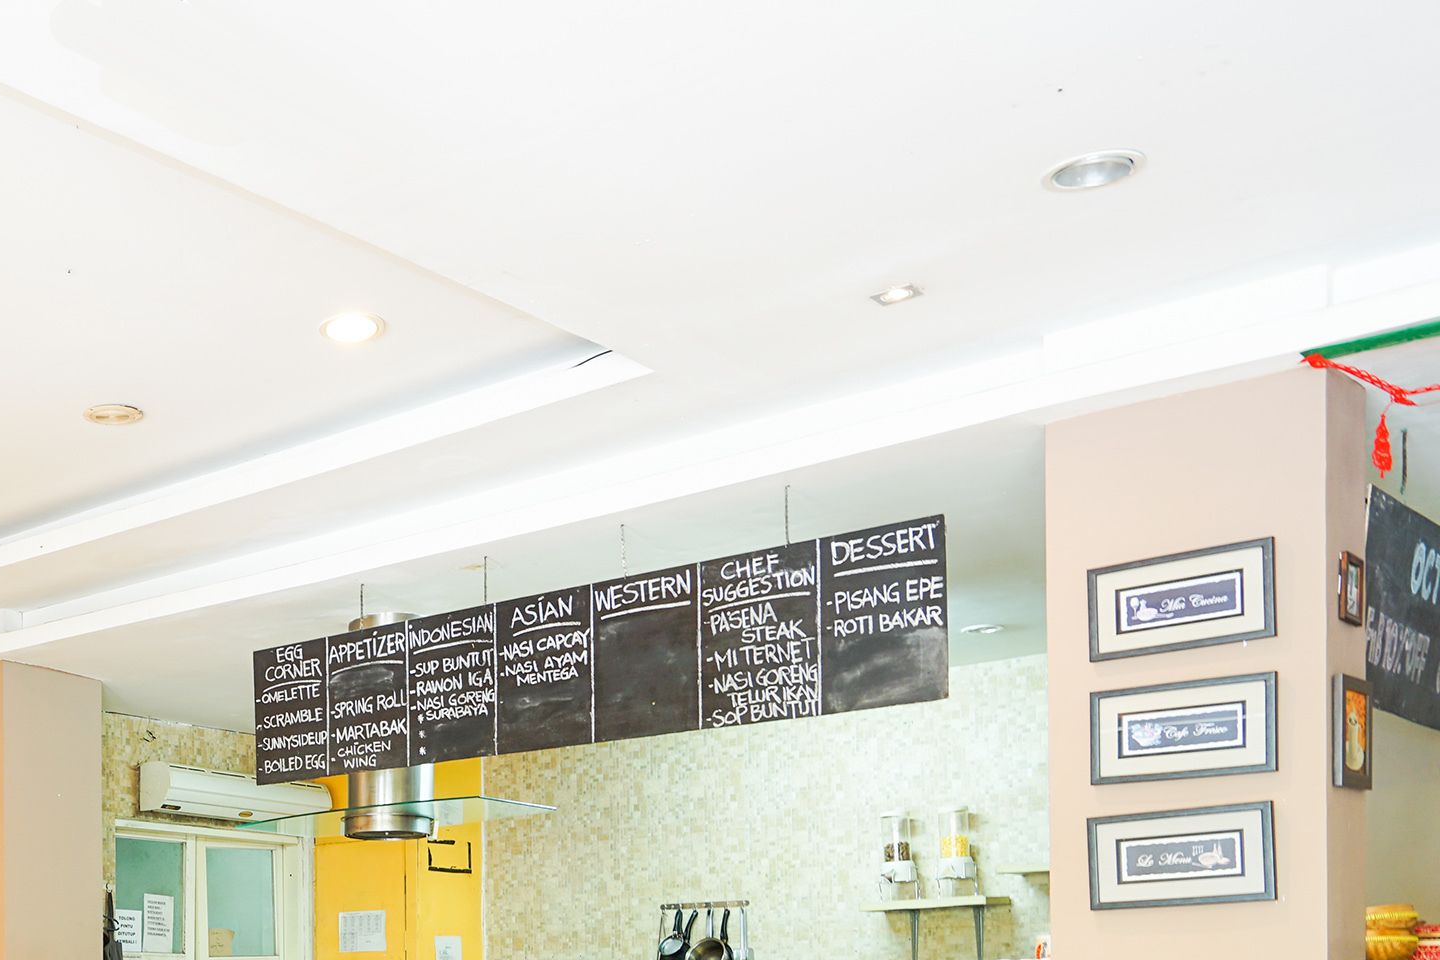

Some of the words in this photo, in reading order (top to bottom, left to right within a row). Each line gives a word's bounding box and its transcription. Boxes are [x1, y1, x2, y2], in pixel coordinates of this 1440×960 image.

[831, 522, 939, 566] DESSERT
[721, 554, 779, 579] CHEF
[594, 569, 691, 611] WESTERN
[702, 567, 816, 606] SUGGESTION
[906, 577, 944, 601] EPE
[511, 596, 573, 628] ASIAN
[879, 605, 944, 633] BAKAR
[409, 612, 494, 648] INDONESIAN
[537, 628, 590, 651] CAPCAY
[741, 619, 807, 644] STEAK
[276, 644, 303, 662] EGG
[328, 632, 405, 664] APPETIZER
[442, 648, 495, 671] BUNTUT
[544, 650, 587, 669] AYAM
[741, 637, 815, 667] TERNET
[265, 659, 321, 682] CORNER
[468, 672, 493, 687] IGA
[517, 669, 578, 686] MENTEGA
[756, 664, 818, 687] GORENG
[377, 690, 408, 711] ROLL
[449, 690, 495, 706] GORENG
[727, 692, 781, 708] TELUR
[782, 684, 819, 705] IKAN
[426, 705, 488, 721] SURABAYA
[750, 700, 819, 720] BUNTUT
[338, 741, 391, 757] CHICKEN
[305, 753, 326, 770] EGG
[344, 755, 377, 768] WING
[1158, 850, 1192, 866] Menu
